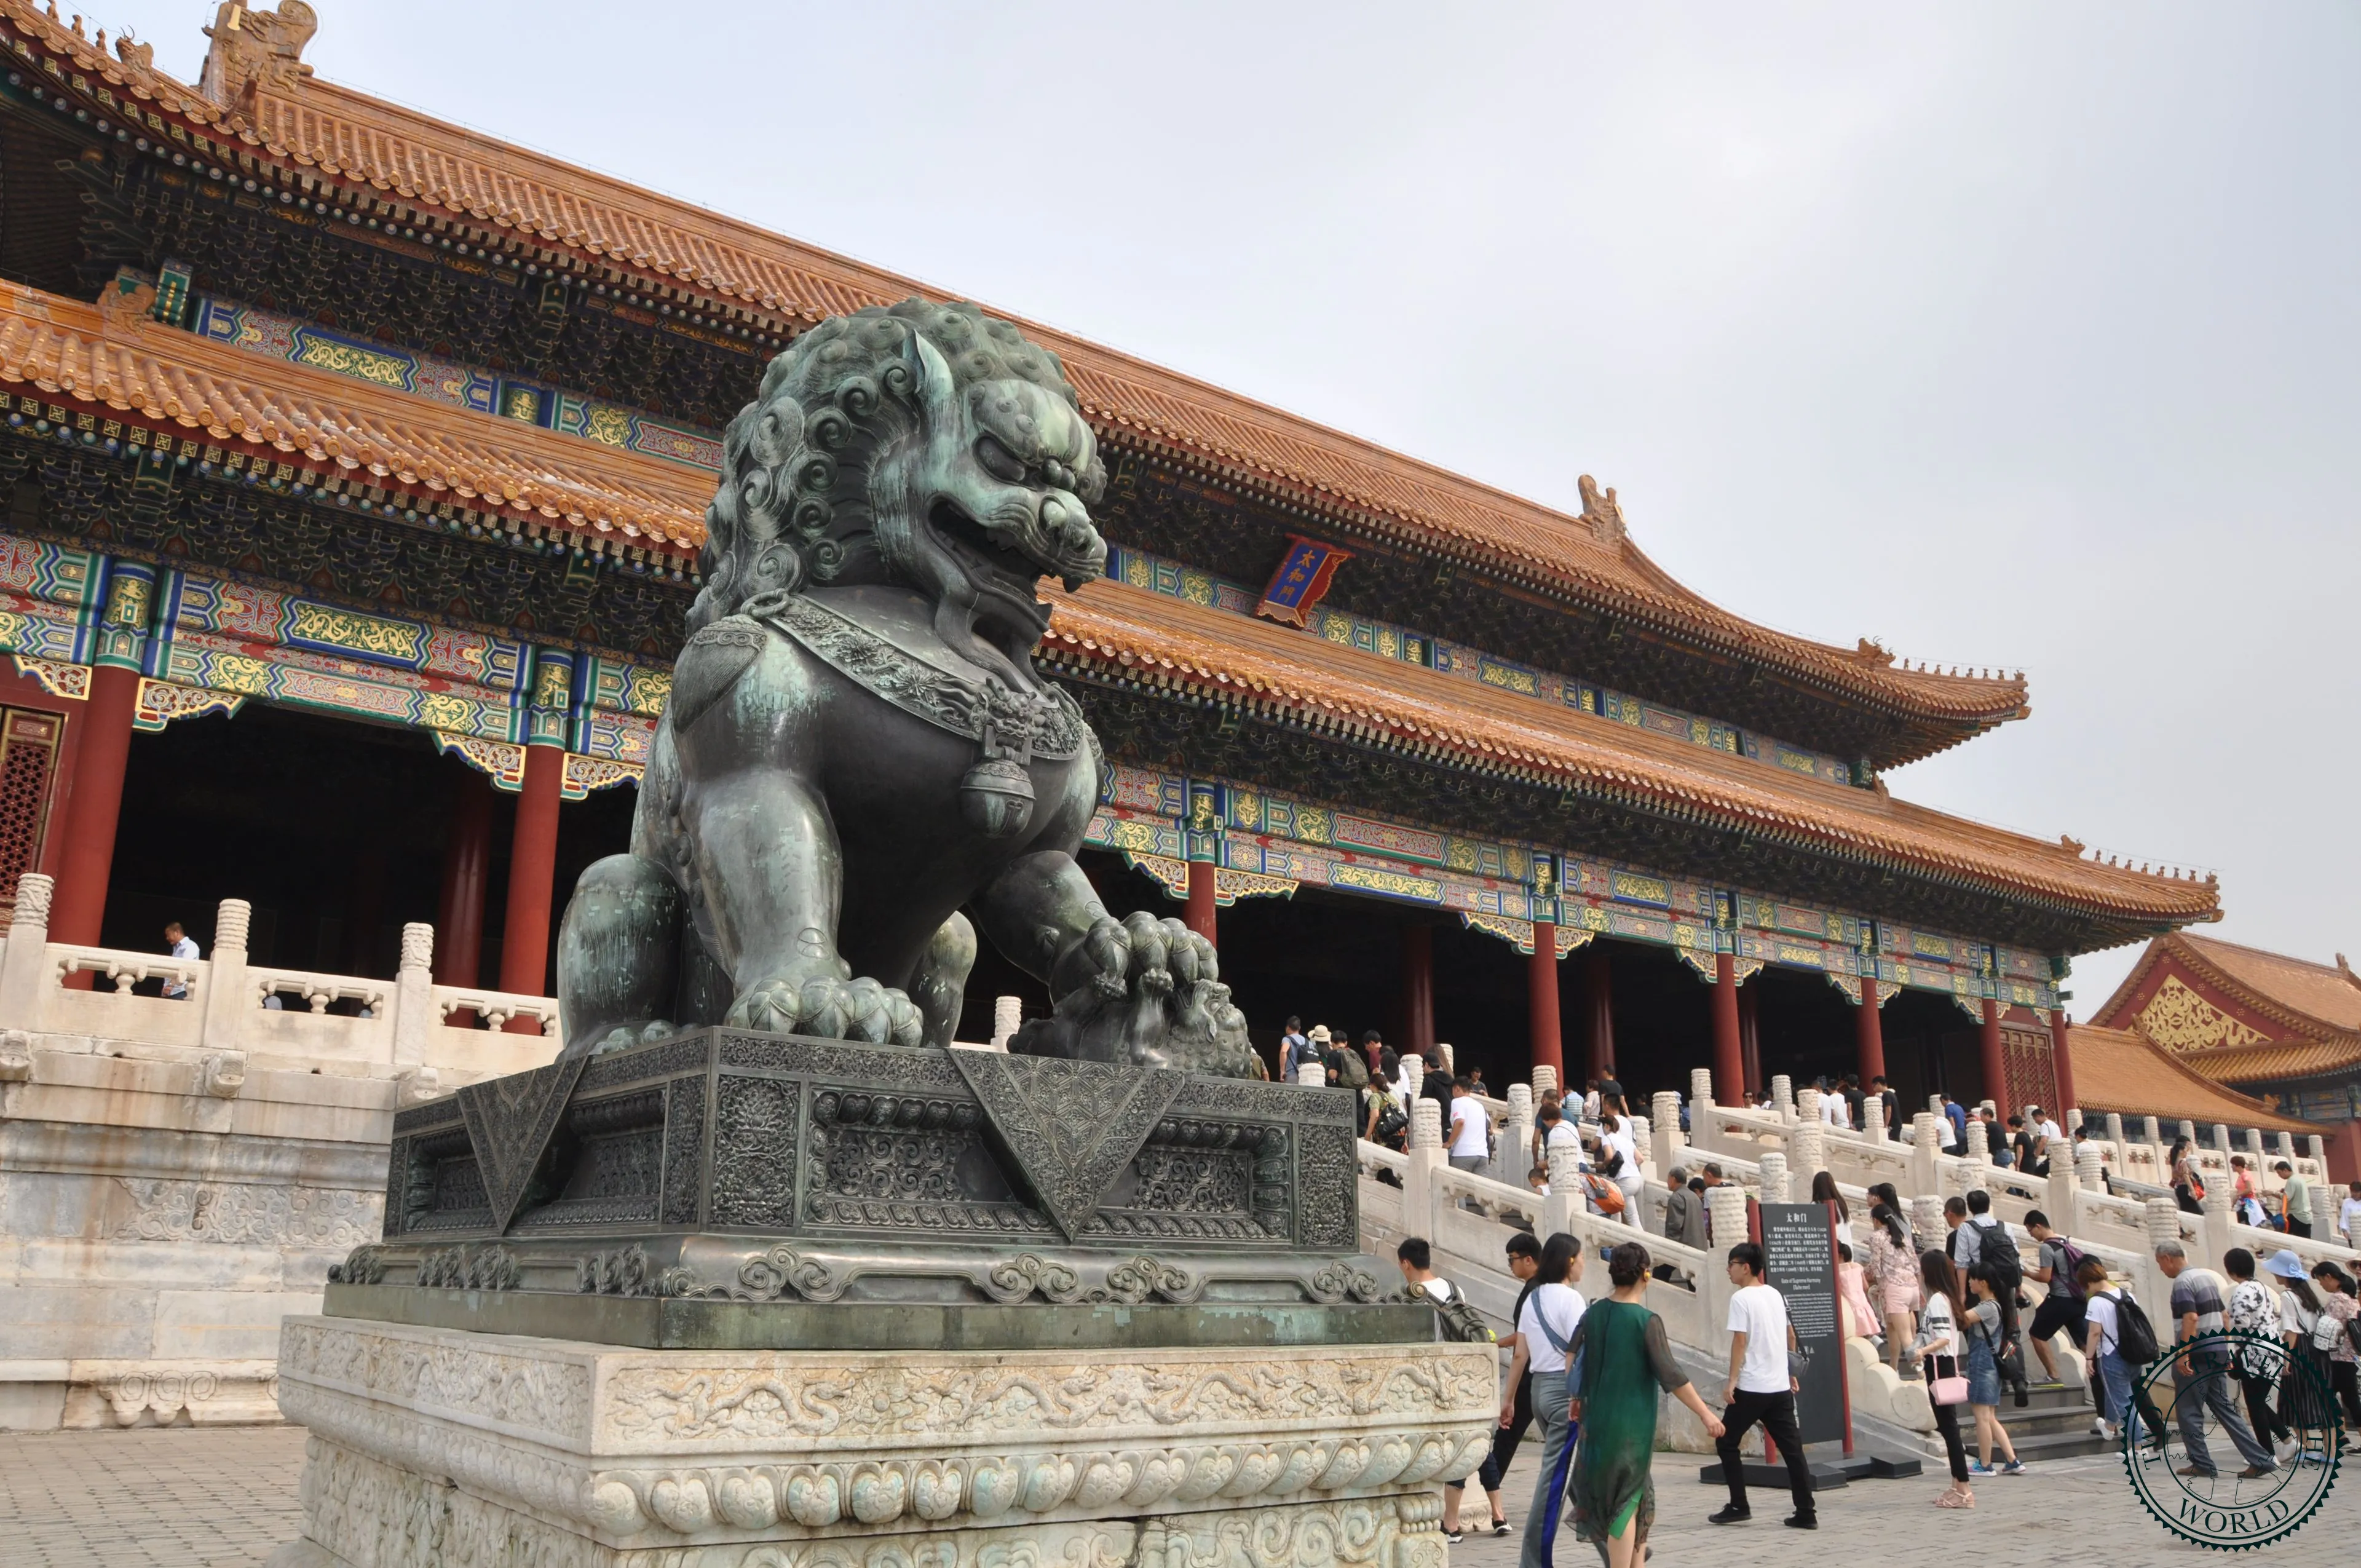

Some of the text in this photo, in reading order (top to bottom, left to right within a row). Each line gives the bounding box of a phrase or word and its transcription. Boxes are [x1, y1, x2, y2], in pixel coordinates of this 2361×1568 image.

[1276, 549, 1316, 603] 太和門
[1786, 1213, 1807, 1223] 太和门
